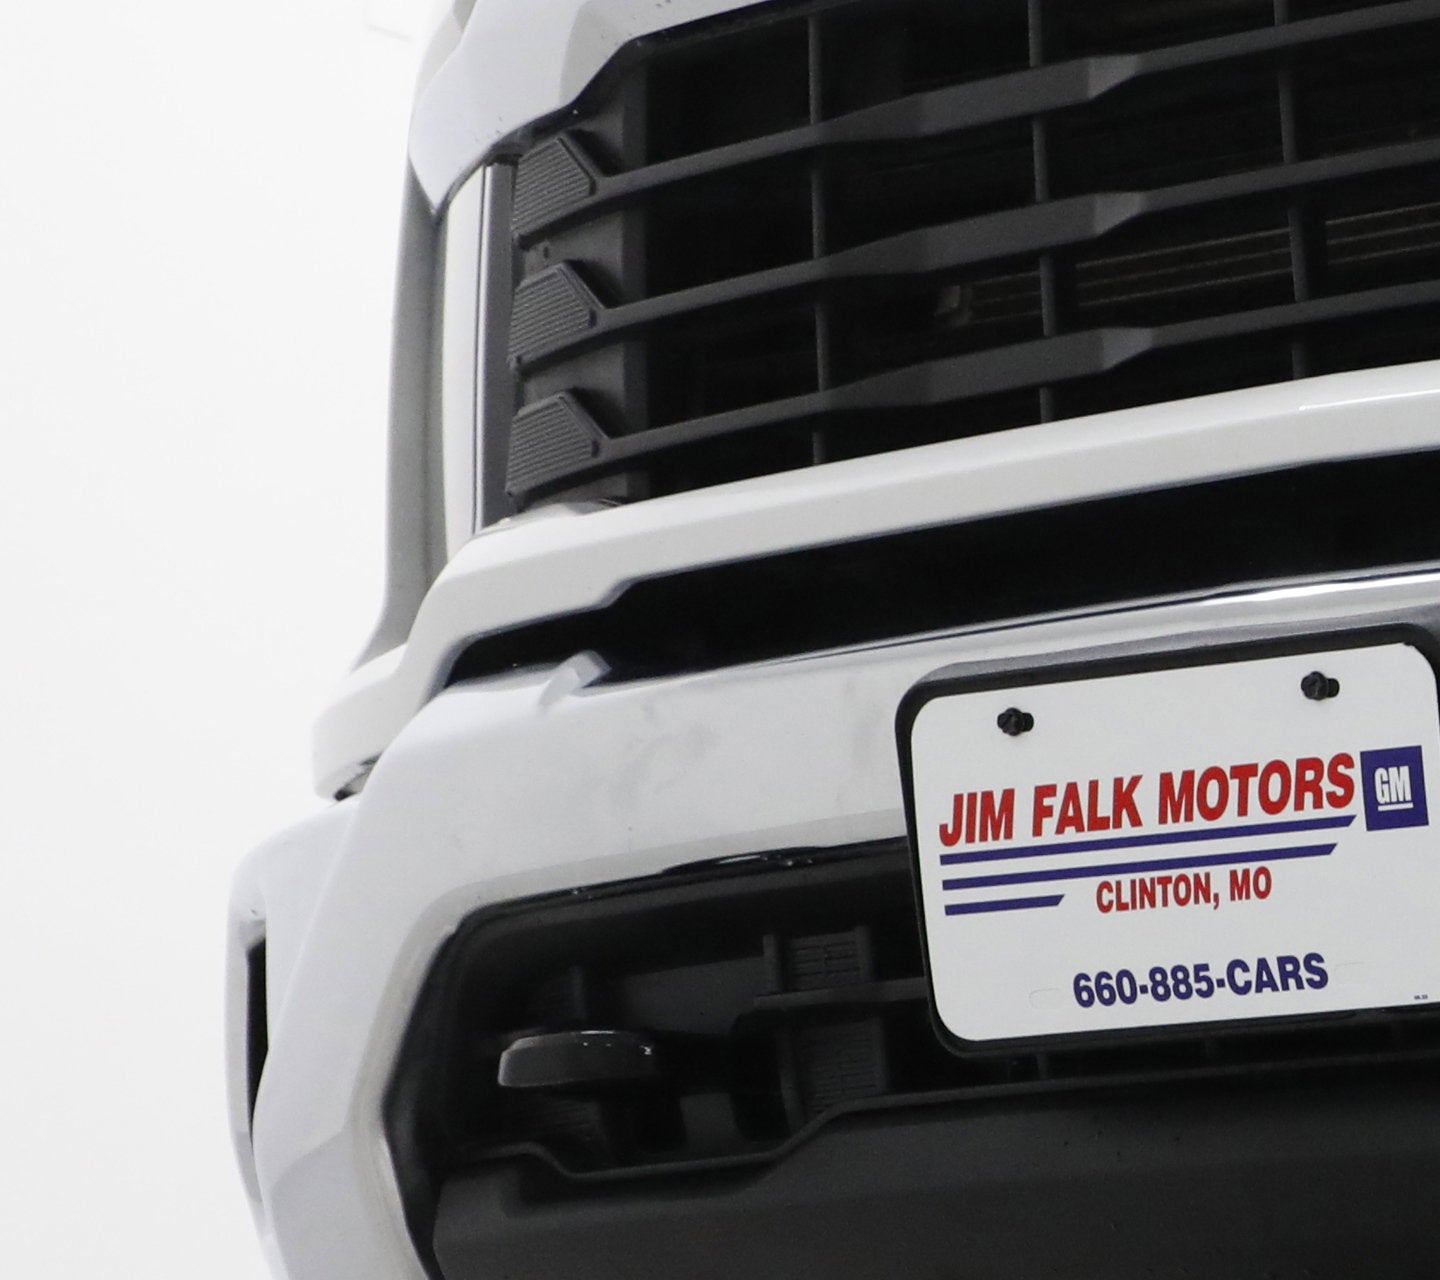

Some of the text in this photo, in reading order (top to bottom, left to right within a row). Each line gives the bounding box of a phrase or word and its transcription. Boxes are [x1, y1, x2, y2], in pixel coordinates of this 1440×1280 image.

[939, 753, 1356, 848] JIM FALK MOTORS
[1374, 765, 1412, 805] GM
[1096, 866, 1272, 914] CLINTON, MO
[1073, 952, 1329, 1009] 660-885-CARS
